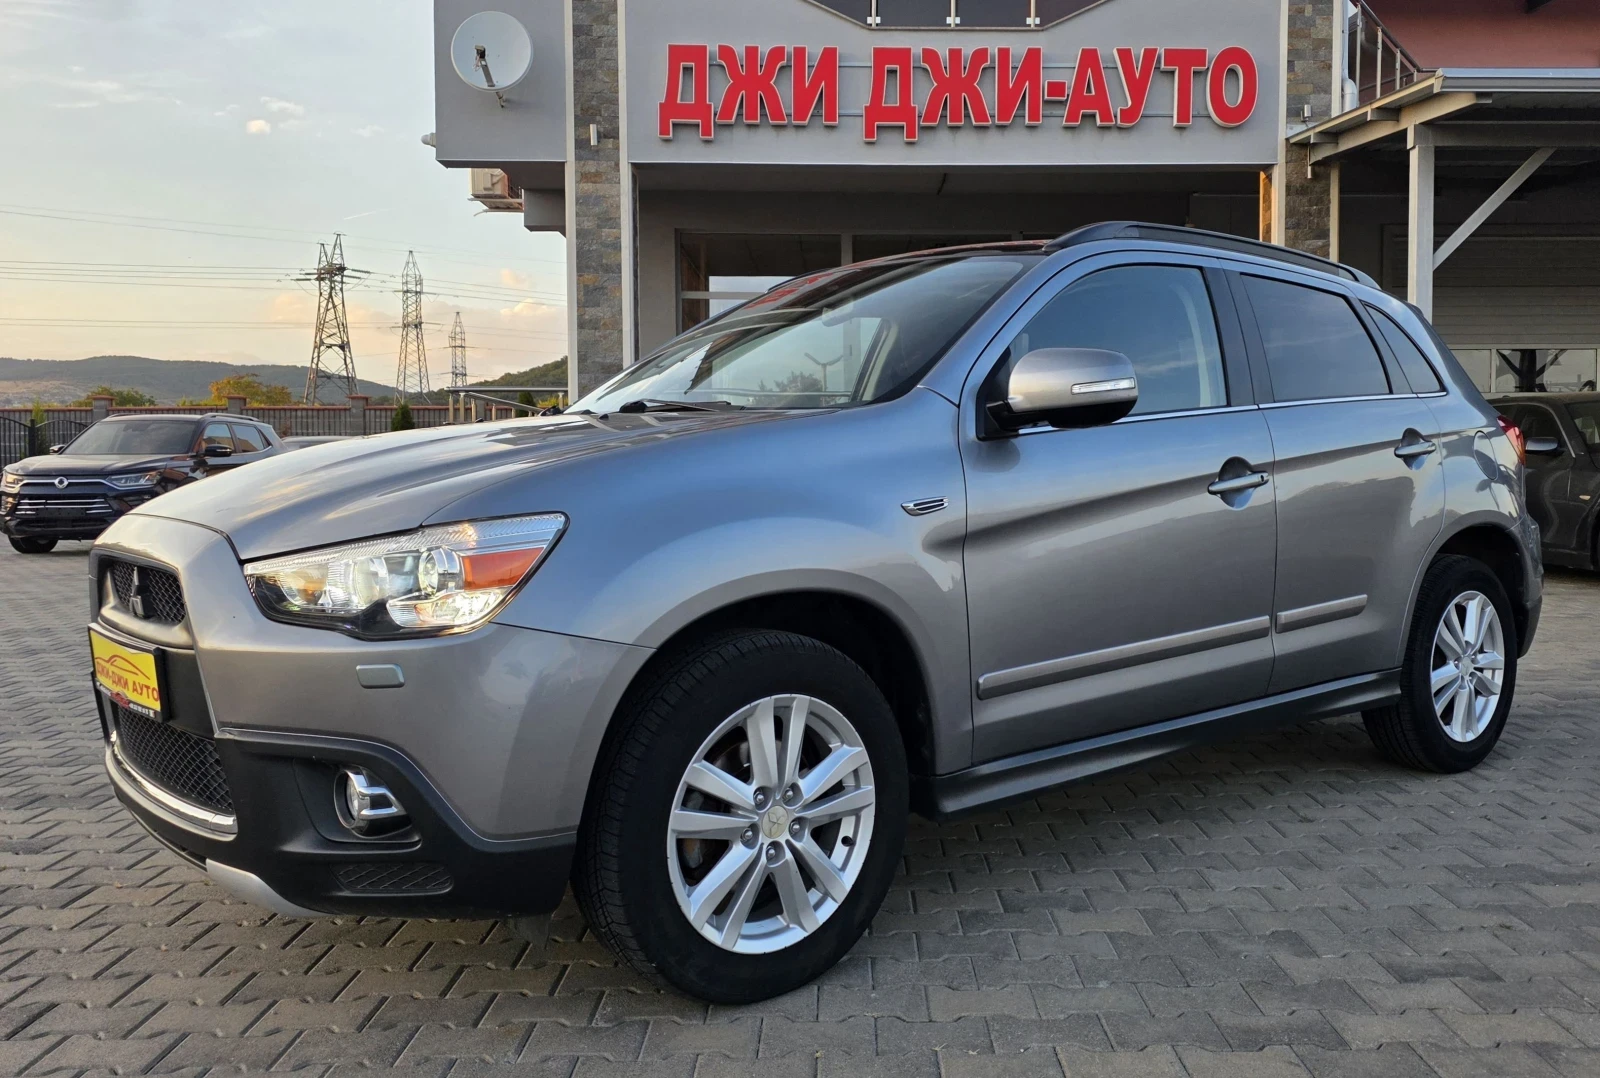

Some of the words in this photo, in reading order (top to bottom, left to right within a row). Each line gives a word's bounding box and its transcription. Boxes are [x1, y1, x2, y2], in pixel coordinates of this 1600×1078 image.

[658, 43, 839, 141] ДЖИ
[863, 45, 1259, 143] ДЖИ-АУТО
[132, 681, 160, 702] АУТО
